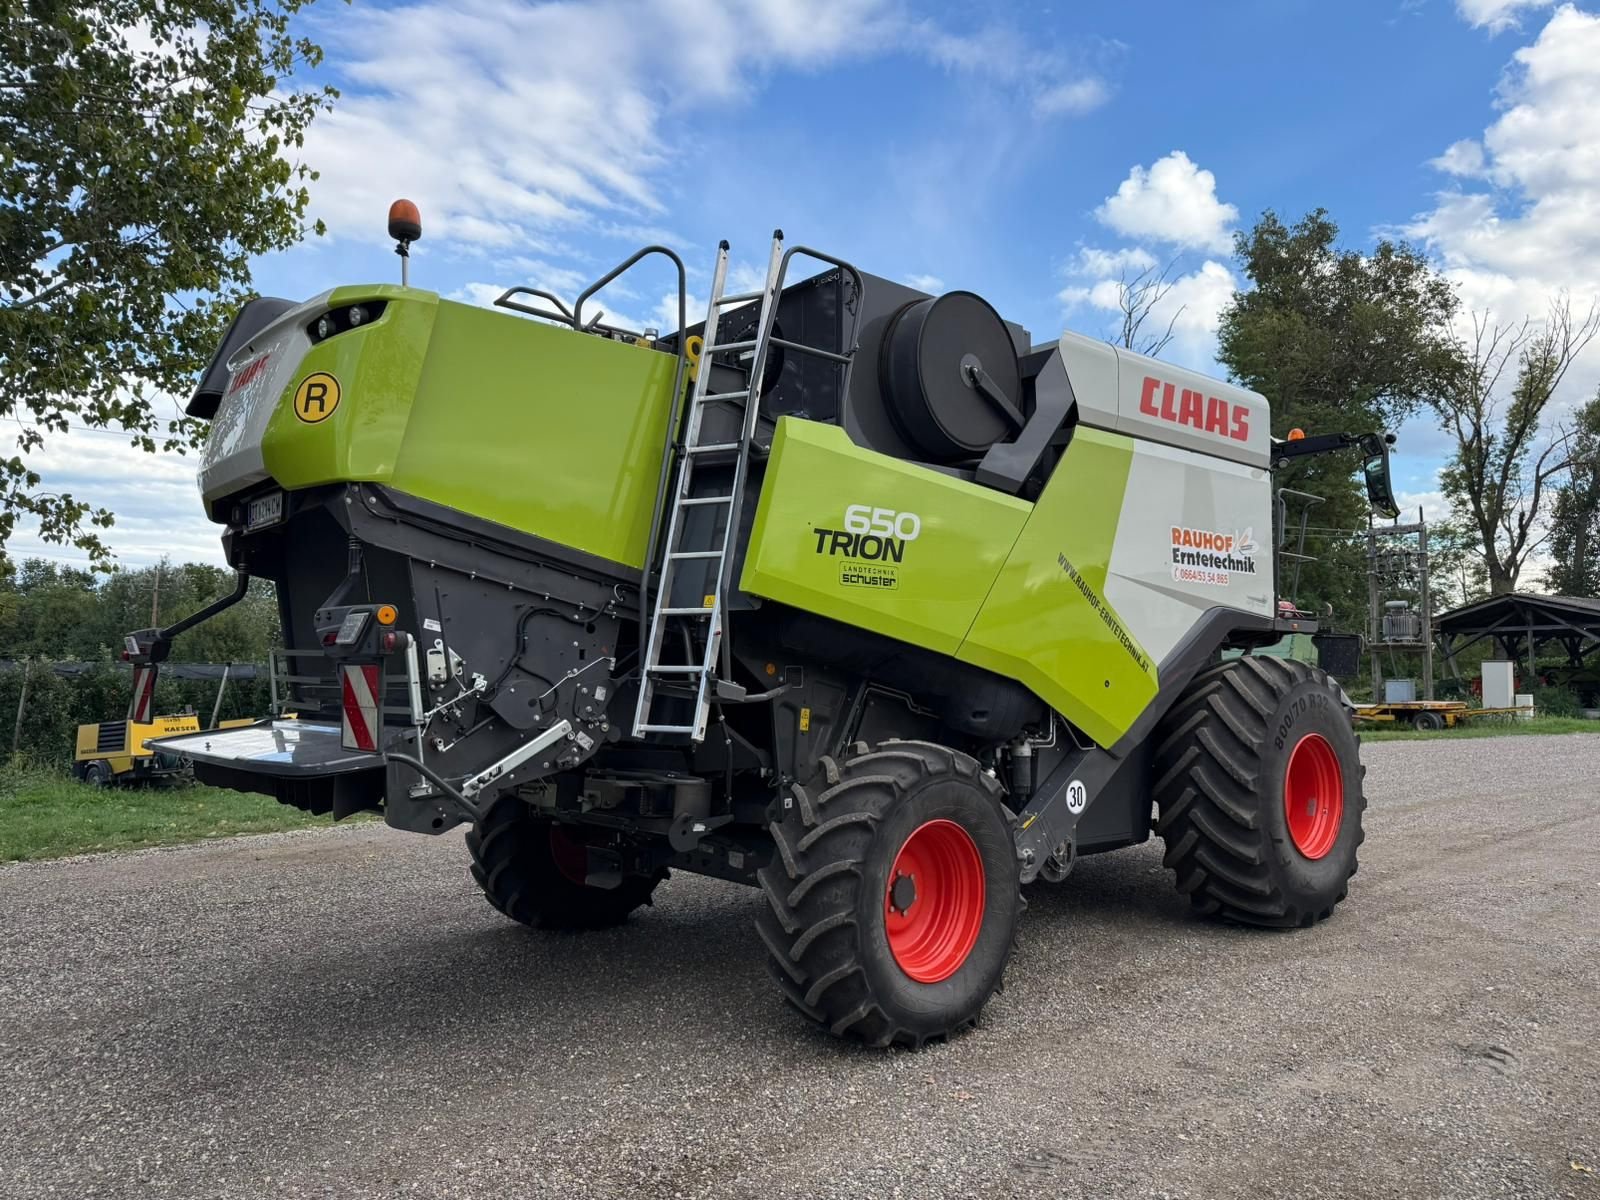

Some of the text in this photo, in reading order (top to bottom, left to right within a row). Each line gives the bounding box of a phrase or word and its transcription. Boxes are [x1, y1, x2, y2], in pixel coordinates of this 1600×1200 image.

[304, 383, 327, 413] R
[1140, 377, 1250, 441] CLAAS
[844, 504, 921, 541] 650
[814, 528, 905, 563] TRION
[1172, 527, 1233, 552] RAUHOF
[843, 565, 895, 576] LANDTECHNIK
[1172, 547, 1256, 574] Erntetechnik
[842, 573, 896, 587] schuster
[1274, 697, 1307, 750] 800/70
[1070, 786, 1083, 807] 30
